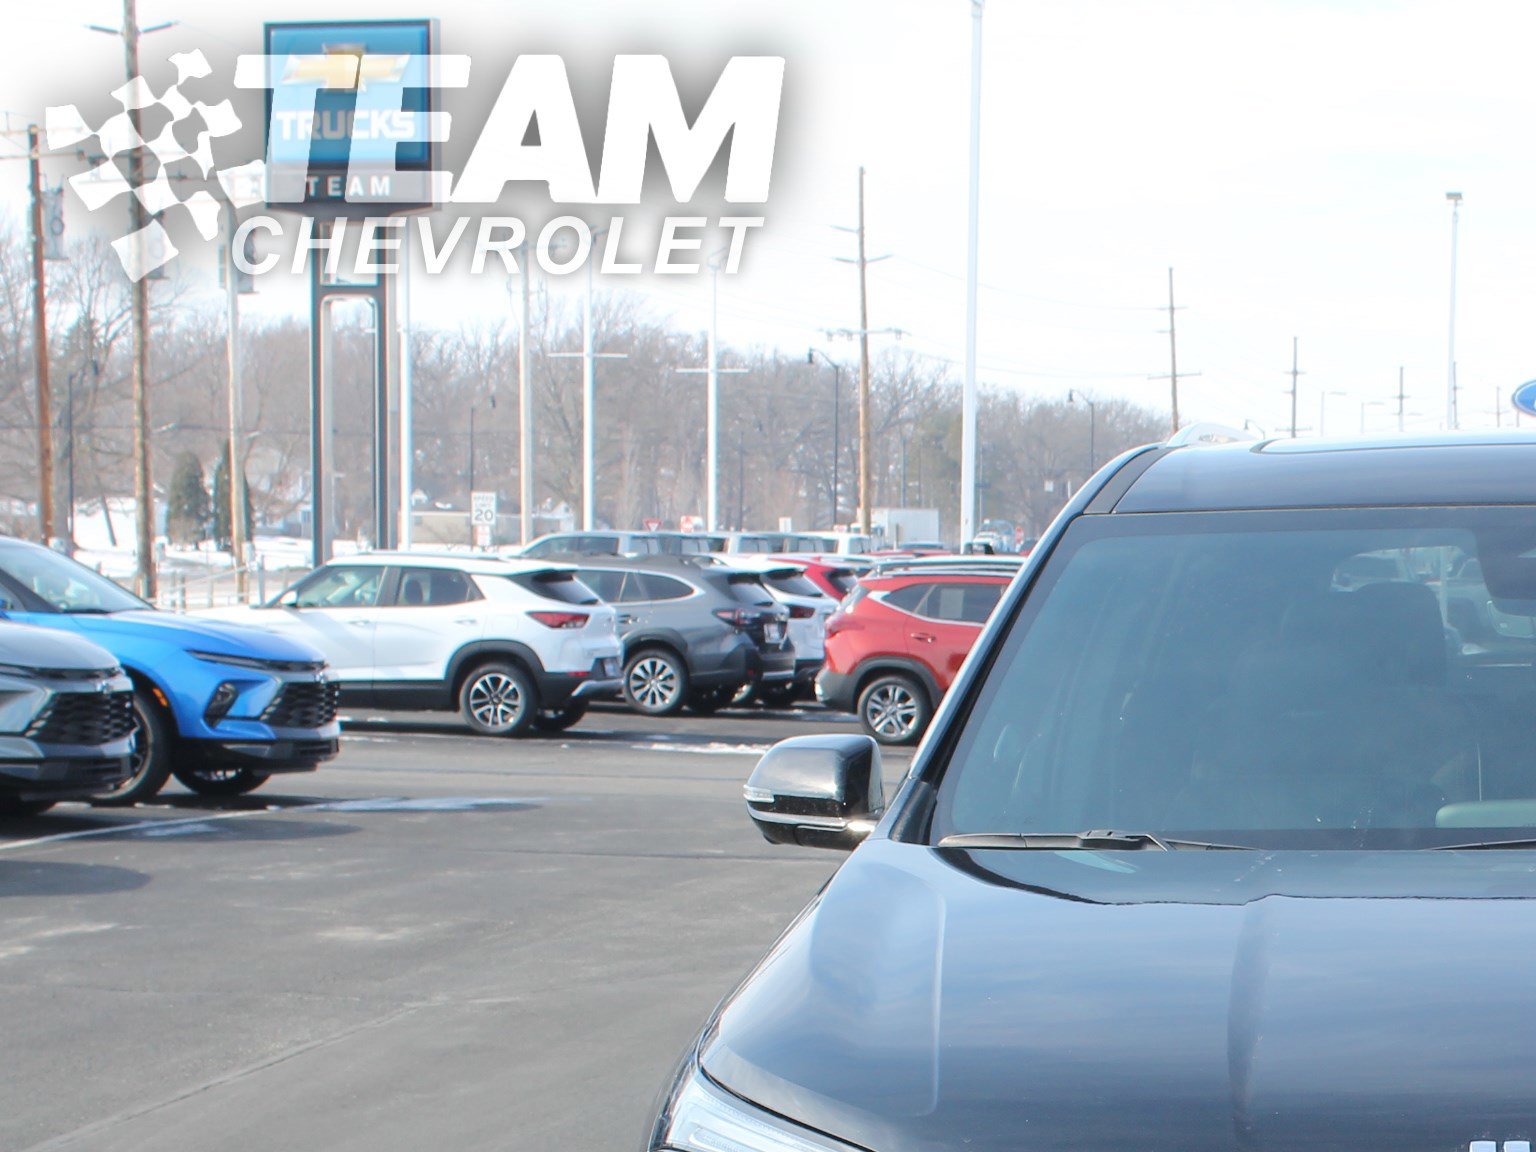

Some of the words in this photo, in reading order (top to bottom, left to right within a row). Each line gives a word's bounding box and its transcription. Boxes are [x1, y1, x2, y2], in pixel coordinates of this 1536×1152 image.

[275, 109, 416, 141] TRUCKS
[306, 175, 391, 197] TEAM
[474, 509, 494, 522] 20
